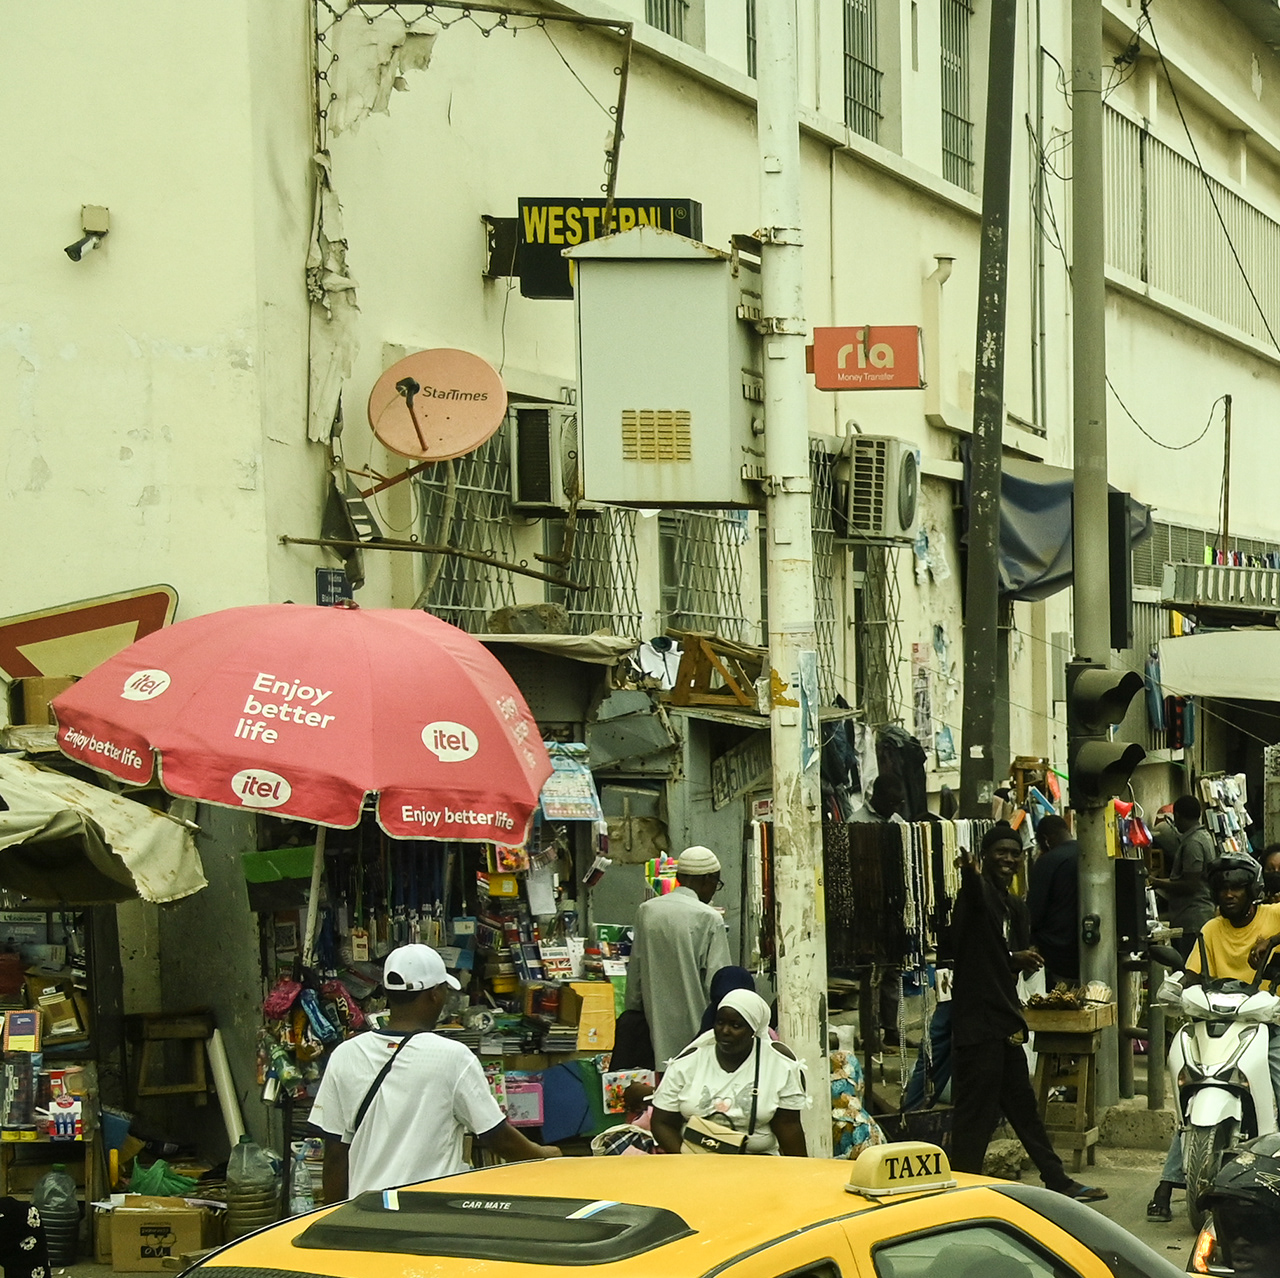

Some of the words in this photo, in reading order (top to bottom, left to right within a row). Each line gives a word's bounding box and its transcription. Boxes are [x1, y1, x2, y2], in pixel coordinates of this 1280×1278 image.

[838, 331, 895, 368] ria
[838, 373, 862, 382] Money
[863, 372, 894, 381] Transfer
[422, 386, 488, 401] StarTimes
[130, 673, 166, 695] itel
[252, 672, 333, 707] Enjoy
[243, 695, 335, 729] better
[234, 718, 279, 744] life
[433, 729, 469, 751] itel
[64, 726, 89, 750] Enjoy
[89, 734, 122, 760] better
[121, 747, 143, 770] life
[242, 775, 282, 801] itel
[401, 805, 442, 827] Enjoy
[444, 807, 494, 825] better
[495, 810, 515, 830] life
[885, 1153, 941, 1180] TAXI
[462, 1201, 482, 1209] CAR
[484, 1202, 511, 1210] MATE
